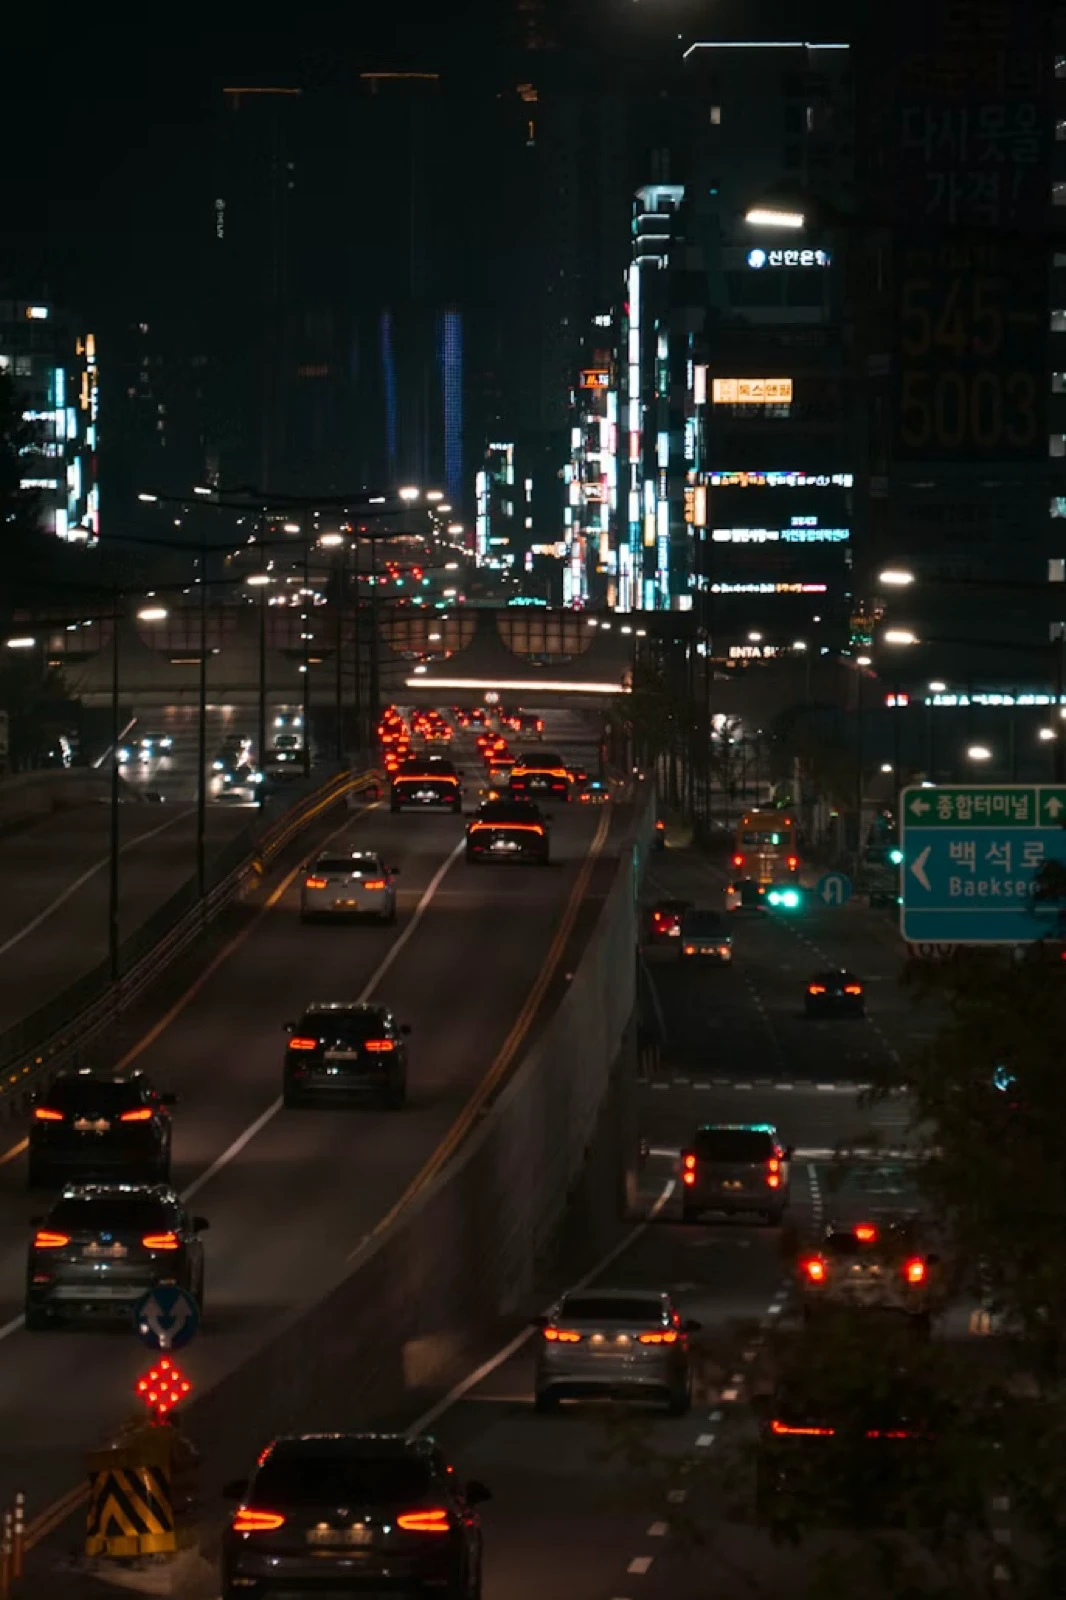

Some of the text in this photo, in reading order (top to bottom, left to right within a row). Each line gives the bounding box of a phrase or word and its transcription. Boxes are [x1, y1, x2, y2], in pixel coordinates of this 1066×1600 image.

[900, 369, 1038, 447] 5003
[936, 795, 1028, 820] 종합터미널
[949, 840, 1045, 874] 백석로
